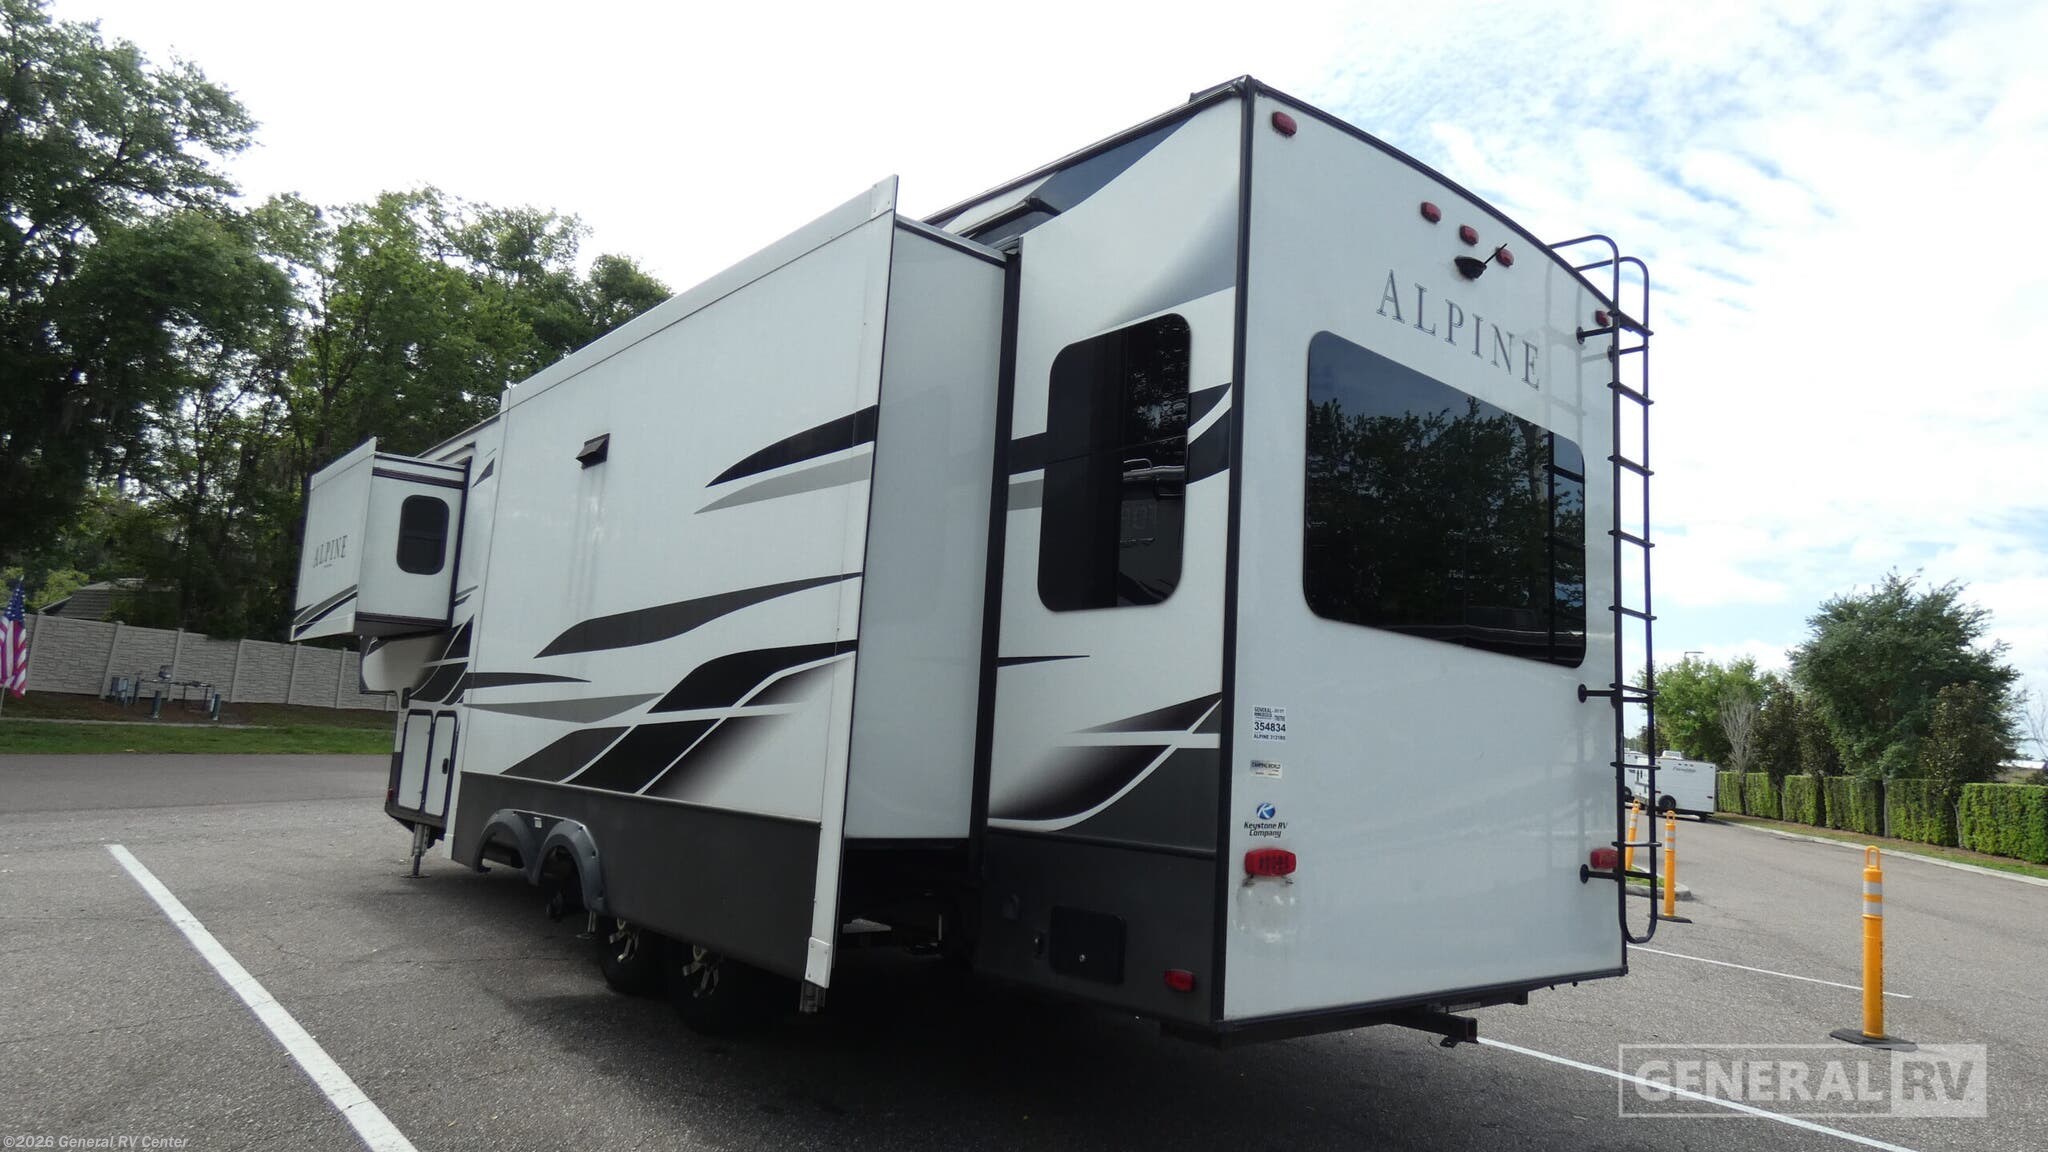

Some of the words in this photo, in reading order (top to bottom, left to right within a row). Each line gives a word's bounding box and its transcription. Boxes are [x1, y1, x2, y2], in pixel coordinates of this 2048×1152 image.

[1376, 269, 1539, 391] ALPINE
[313, 534, 348, 568] ALPINE
[1254, 722, 1286, 732] 354834
[1244, 822, 1277, 830] Keystone
[1249, 829, 1282, 838] Company
